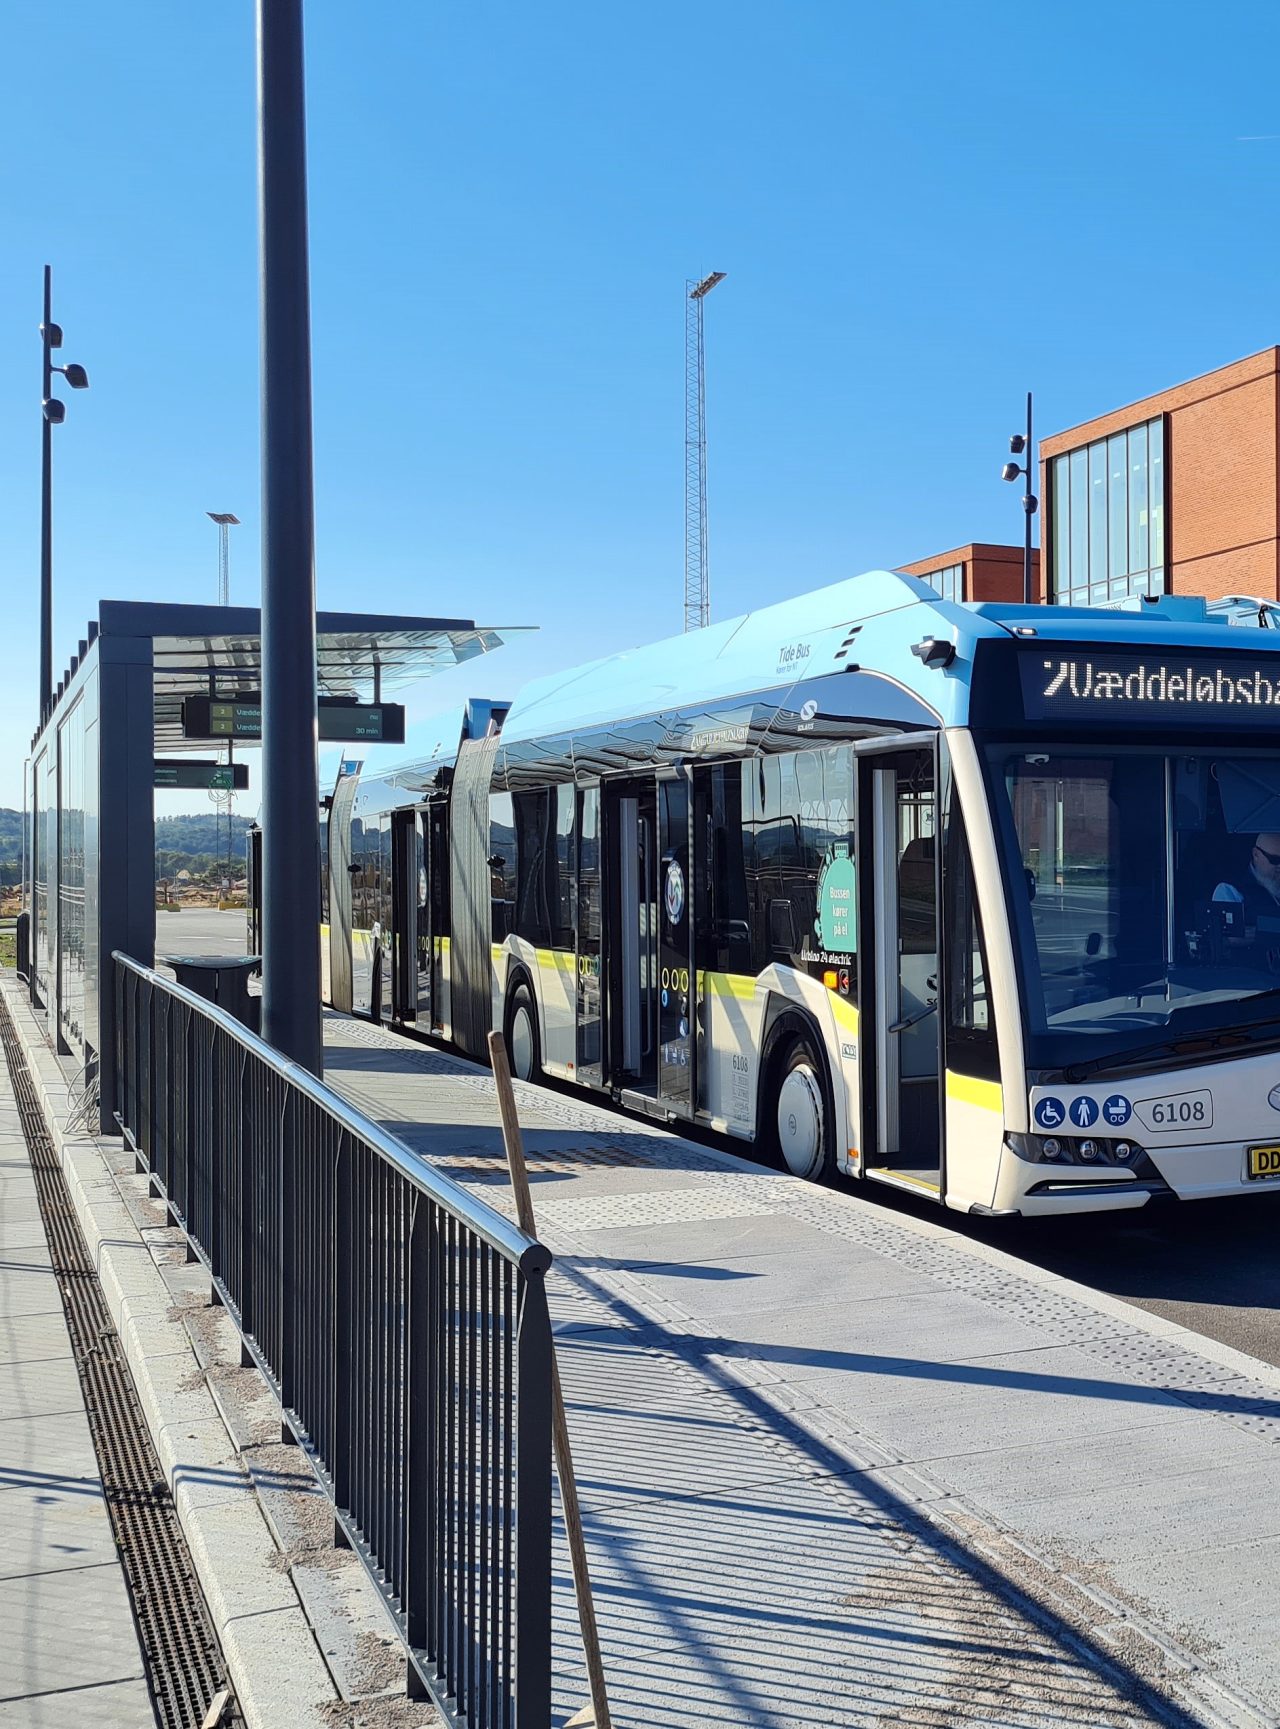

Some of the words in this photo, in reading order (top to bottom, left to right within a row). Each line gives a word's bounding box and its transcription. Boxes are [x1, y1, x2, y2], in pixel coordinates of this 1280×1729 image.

[780, 645, 796, 663] Tide
[796, 643, 811, 659] Bus
[236, 708, 262, 717] Vædde
[236, 723, 262, 731] Vædde
[355, 727, 365, 735] 30
[365, 727, 379, 735] min
[829, 886, 851, 899] Bussen
[832, 904, 849, 917] kører
[833, 923, 841, 937] på
[841, 922, 848, 936] el
[820, 951, 828, 963] 24
[828, 953, 852, 965] electric
[732, 1054, 749, 1073] 6108
[1152, 1101, 1205, 1124] 6108
[1258, 1151, 1280, 1171] DD
